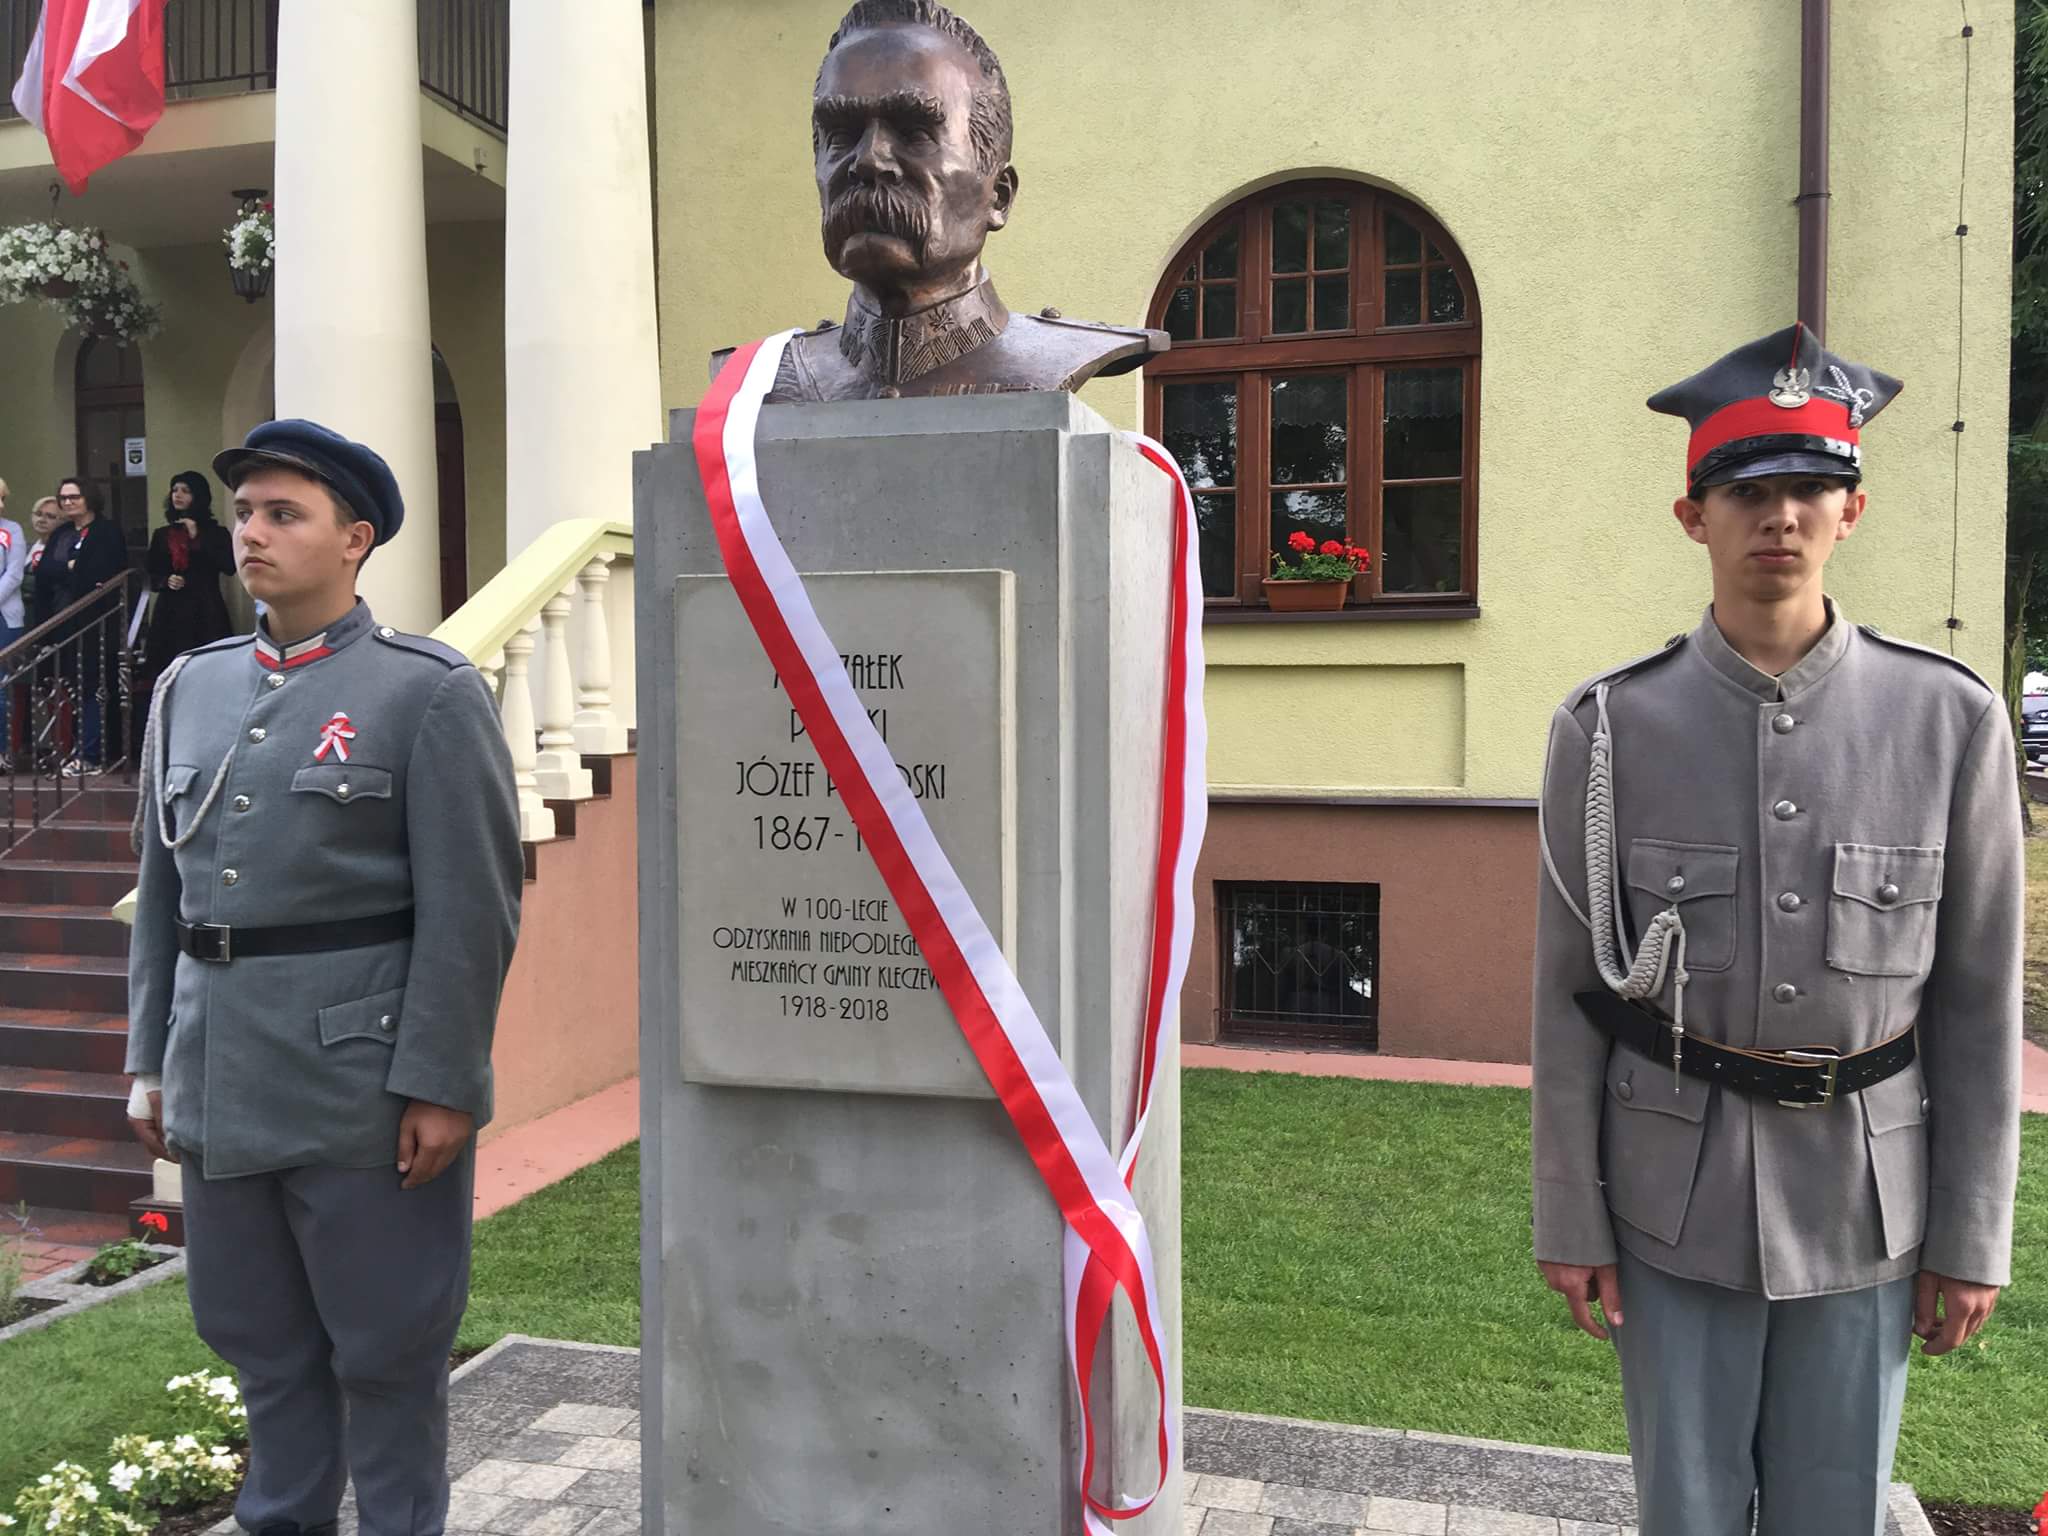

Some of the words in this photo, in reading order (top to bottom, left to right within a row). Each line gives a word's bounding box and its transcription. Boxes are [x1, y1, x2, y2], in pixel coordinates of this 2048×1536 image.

[735, 755, 816, 797] JÓZEF
[753, 815, 862, 852] 1867-1
[781, 897, 798, 918] W
[805, 898, 889, 922] 100-LECIE
[712, 927, 811, 952] ODZYSKANIA
[820, 931, 921, 956] NIEPODLEGŁ
[731, 959, 818, 985] MIESZKAŃCY
[824, 964, 873, 988] GMINY
[779, 995, 889, 1021] 1918-2018
